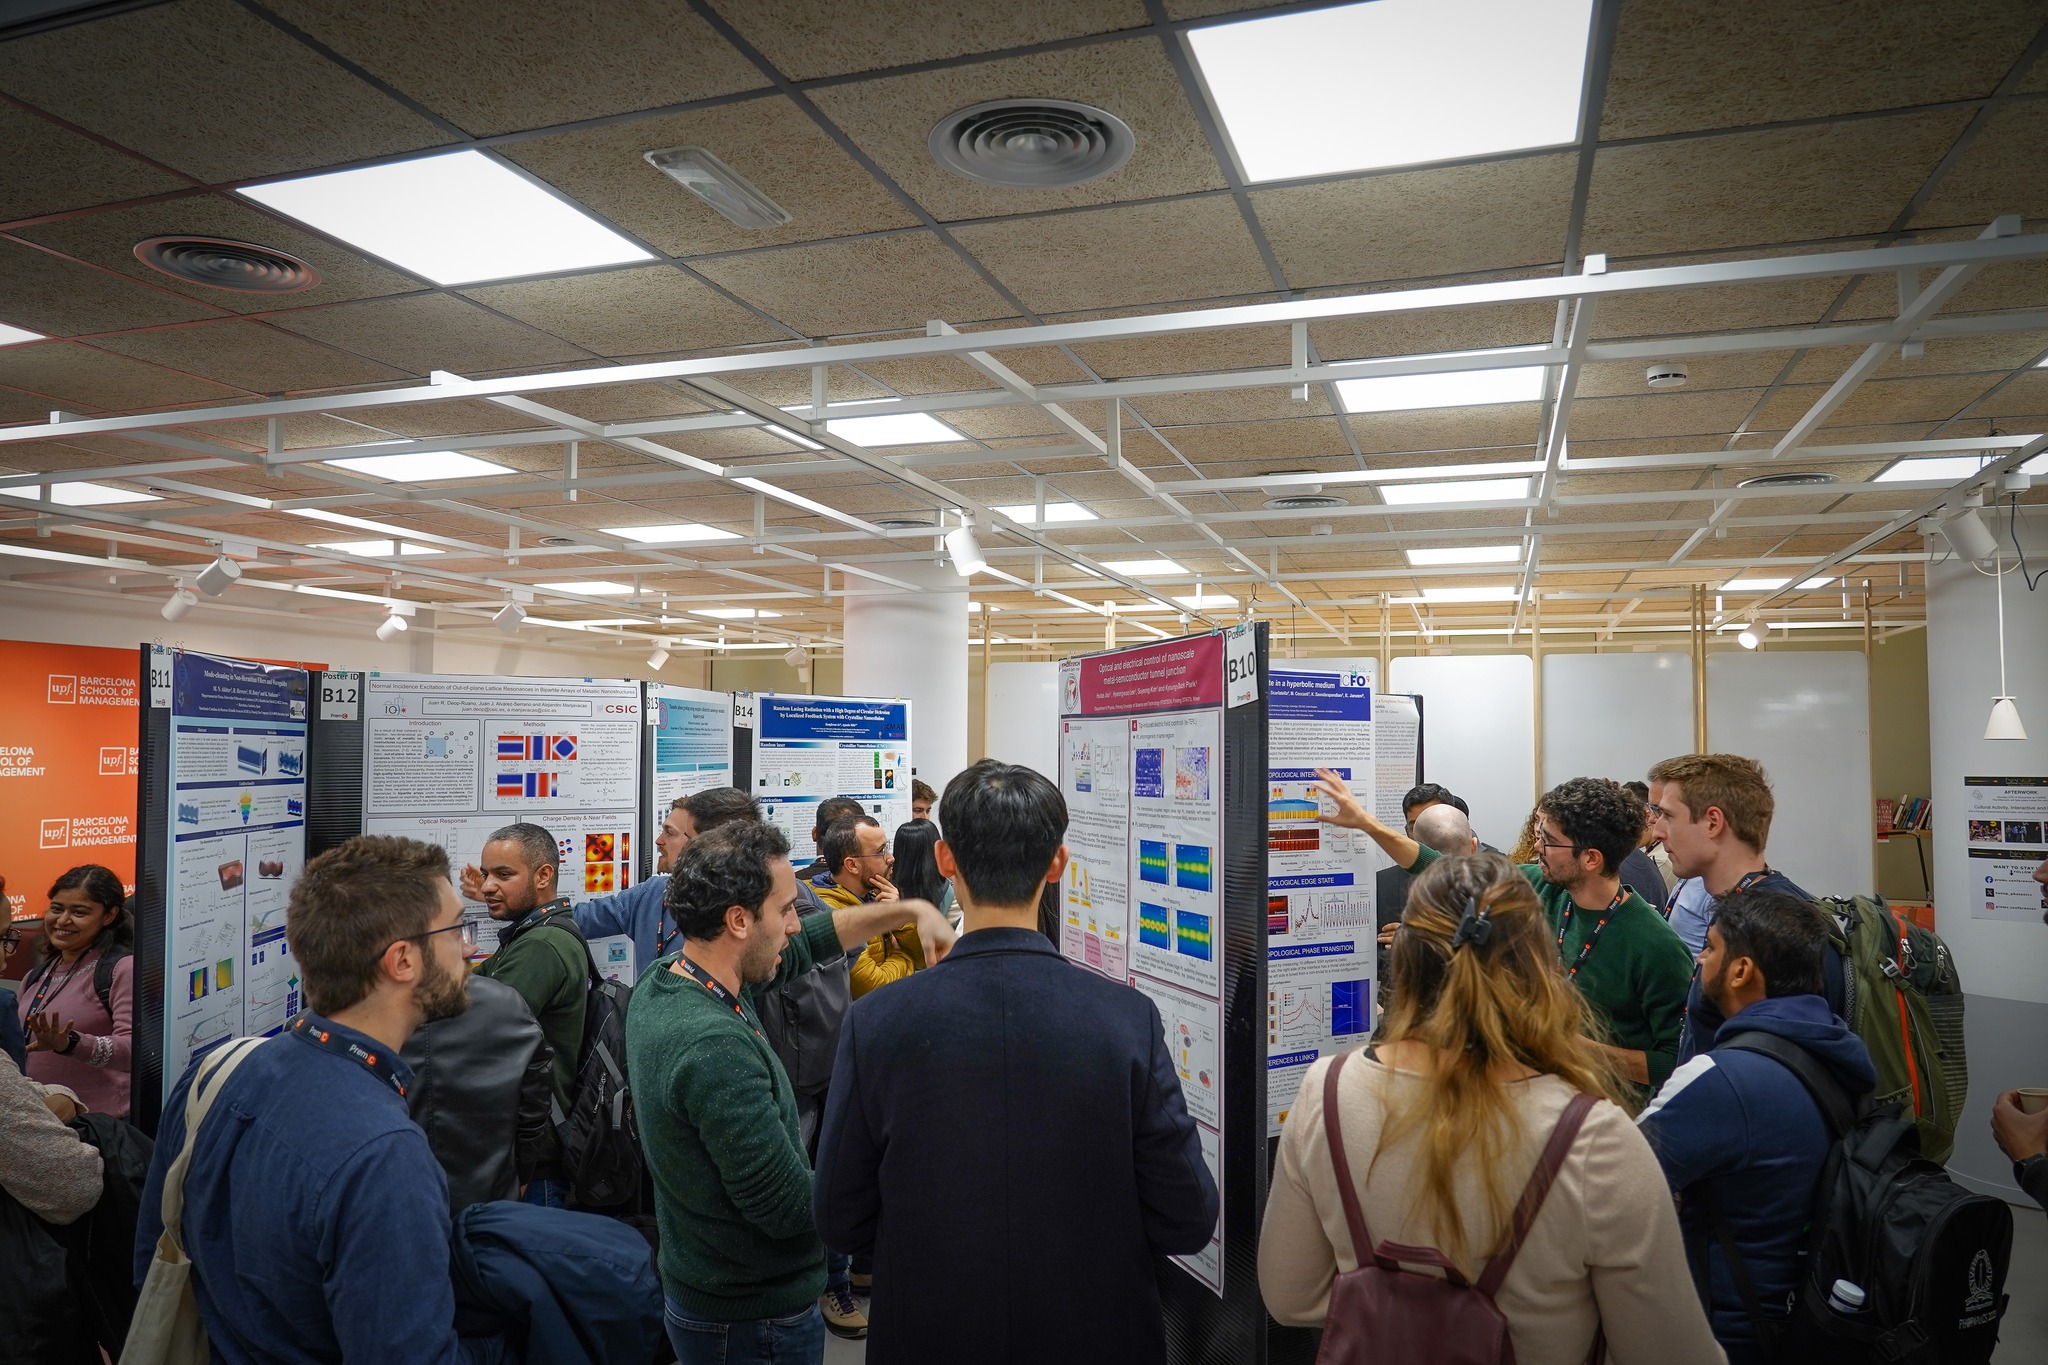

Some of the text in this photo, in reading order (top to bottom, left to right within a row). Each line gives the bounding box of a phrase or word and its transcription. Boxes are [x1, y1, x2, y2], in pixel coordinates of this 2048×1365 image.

[1248, 620, 1253, 632] ID
[1099, 662, 1113, 674] Optical
[1123, 657, 1142, 669] electrical
[1144, 654, 1160, 666] control
[1162, 653, 1167, 663] of
[1168, 648, 1194, 661] nanoscale
[1229, 651, 1254, 683] B10
[151, 670, 170, 688] B11
[1104, 665, 1186, 685] metal-semiconductor tunnel junction
[80, 676, 136, 687] BARCELONA
[52, 683, 73, 696] upf.
[80, 686, 134, 696] SCHOOL OF
[322, 688, 357, 703] B12
[80, 696, 140, 706] MANAGEMEN
[605, 705, 638, 714] CSIC
[735, 705, 753, 717] B14
[0, 747, 34, 756] ELONA
[17, 758, 32, 766] OF
[103, 754, 122, 767] upf.
[0, 768, 46, 776] AGEMENT
[72, 816, 129, 827] BARCELONA
[44, 826, 66, 840] upf.
[72, 826, 126, 837] SCHOOL OF
[72, 834, 137, 846] MANAGEMENT
[706, 980, 726, 998] PremC
[309, 1026, 330, 1042] PremC
[349, 1044, 377, 1066] PremC
[1268, 1057, 1294, 1066] ERENCES
